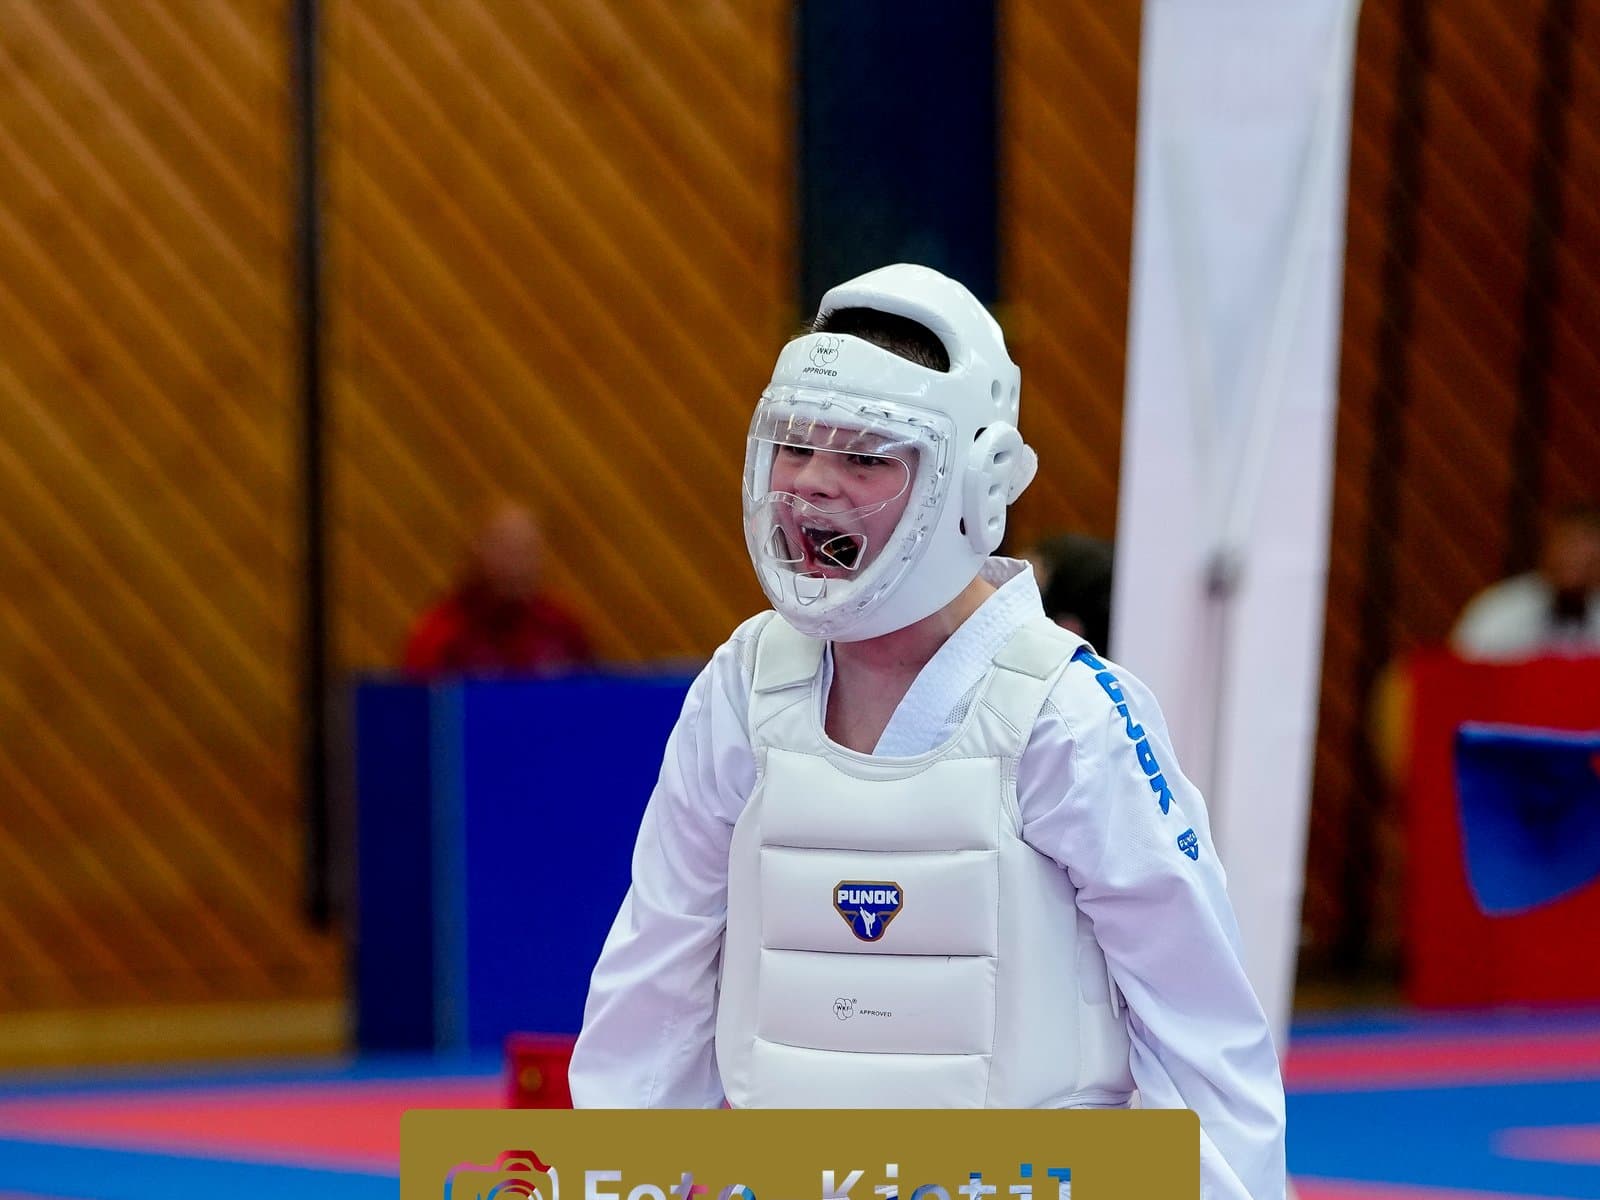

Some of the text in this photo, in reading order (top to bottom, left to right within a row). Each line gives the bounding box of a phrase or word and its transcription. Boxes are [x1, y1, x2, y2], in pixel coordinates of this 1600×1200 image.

[816, 347, 835, 355] WKF
[803, 367, 838, 377] APPROVED
[837, 889, 899, 905] PUNOK
[859, 1009, 892, 1018] APPROVED
